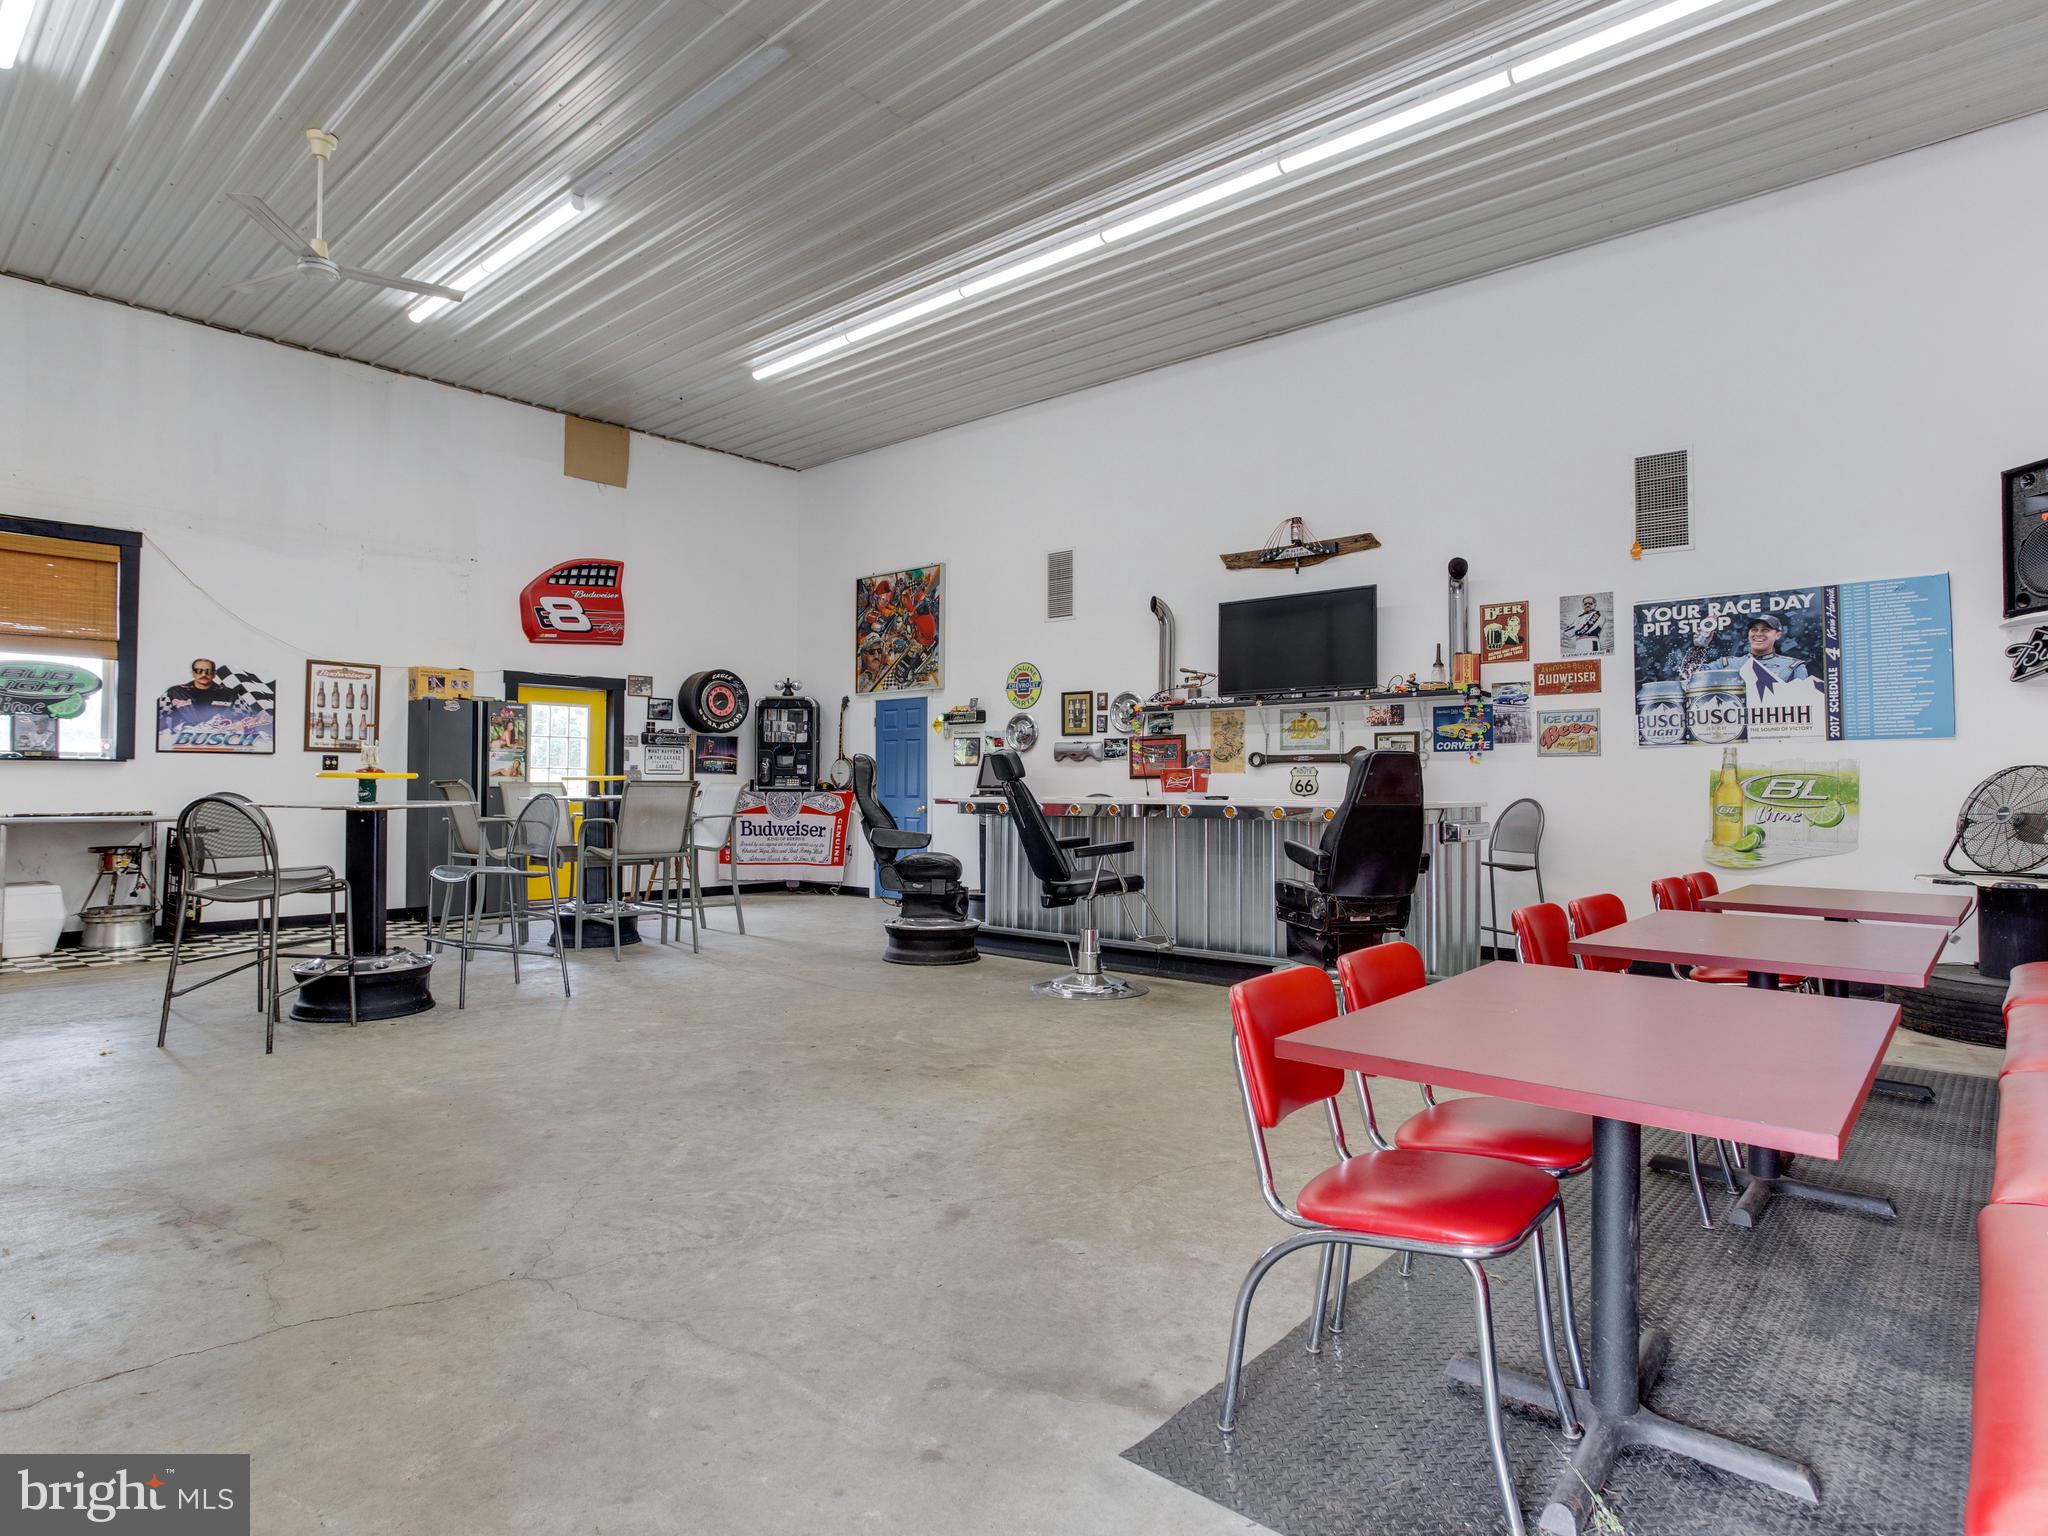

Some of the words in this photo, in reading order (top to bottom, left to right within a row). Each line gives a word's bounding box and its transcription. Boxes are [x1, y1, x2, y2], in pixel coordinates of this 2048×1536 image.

[571, 590, 619, 598] Budweiser
[540, 597, 592, 632] 8
[1484, 605, 1525, 621] BEER
[1642, 604, 1700, 622] YOUR
[1708, 599, 1761, 616] RACE
[1769, 593, 1815, 611] DAY
[1643, 621, 1671, 637] PIT
[1678, 616, 1731, 634] STOP
[1825, 647, 1840, 661] 4
[0, 668, 75, 681] BUD
[1010, 666, 1038, 679] GENUINE
[1538, 671, 1596, 686] BUDWEISER
[0, 680, 85, 693] IGHT
[1828, 667, 1839, 713] SCHEDULE
[0, 697, 46, 714] ime
[1012, 697, 1035, 706] PARTS
[1543, 715, 1561, 724] ICE
[1563, 714, 1594, 723] COLD
[1638, 714, 1687, 730] BUSCH
[1830, 716, 1840, 738] 2017
[172, 732, 261, 747] BUSCH
[1540, 723, 1598, 750] Beer
[1647, 729, 1680, 737] LIGHT
[1295, 780, 1313, 793] 66
[1761, 778, 1830, 800] BL
[740, 820, 826, 838] Budweiser
[833, 817, 843, 864] GENUINE
